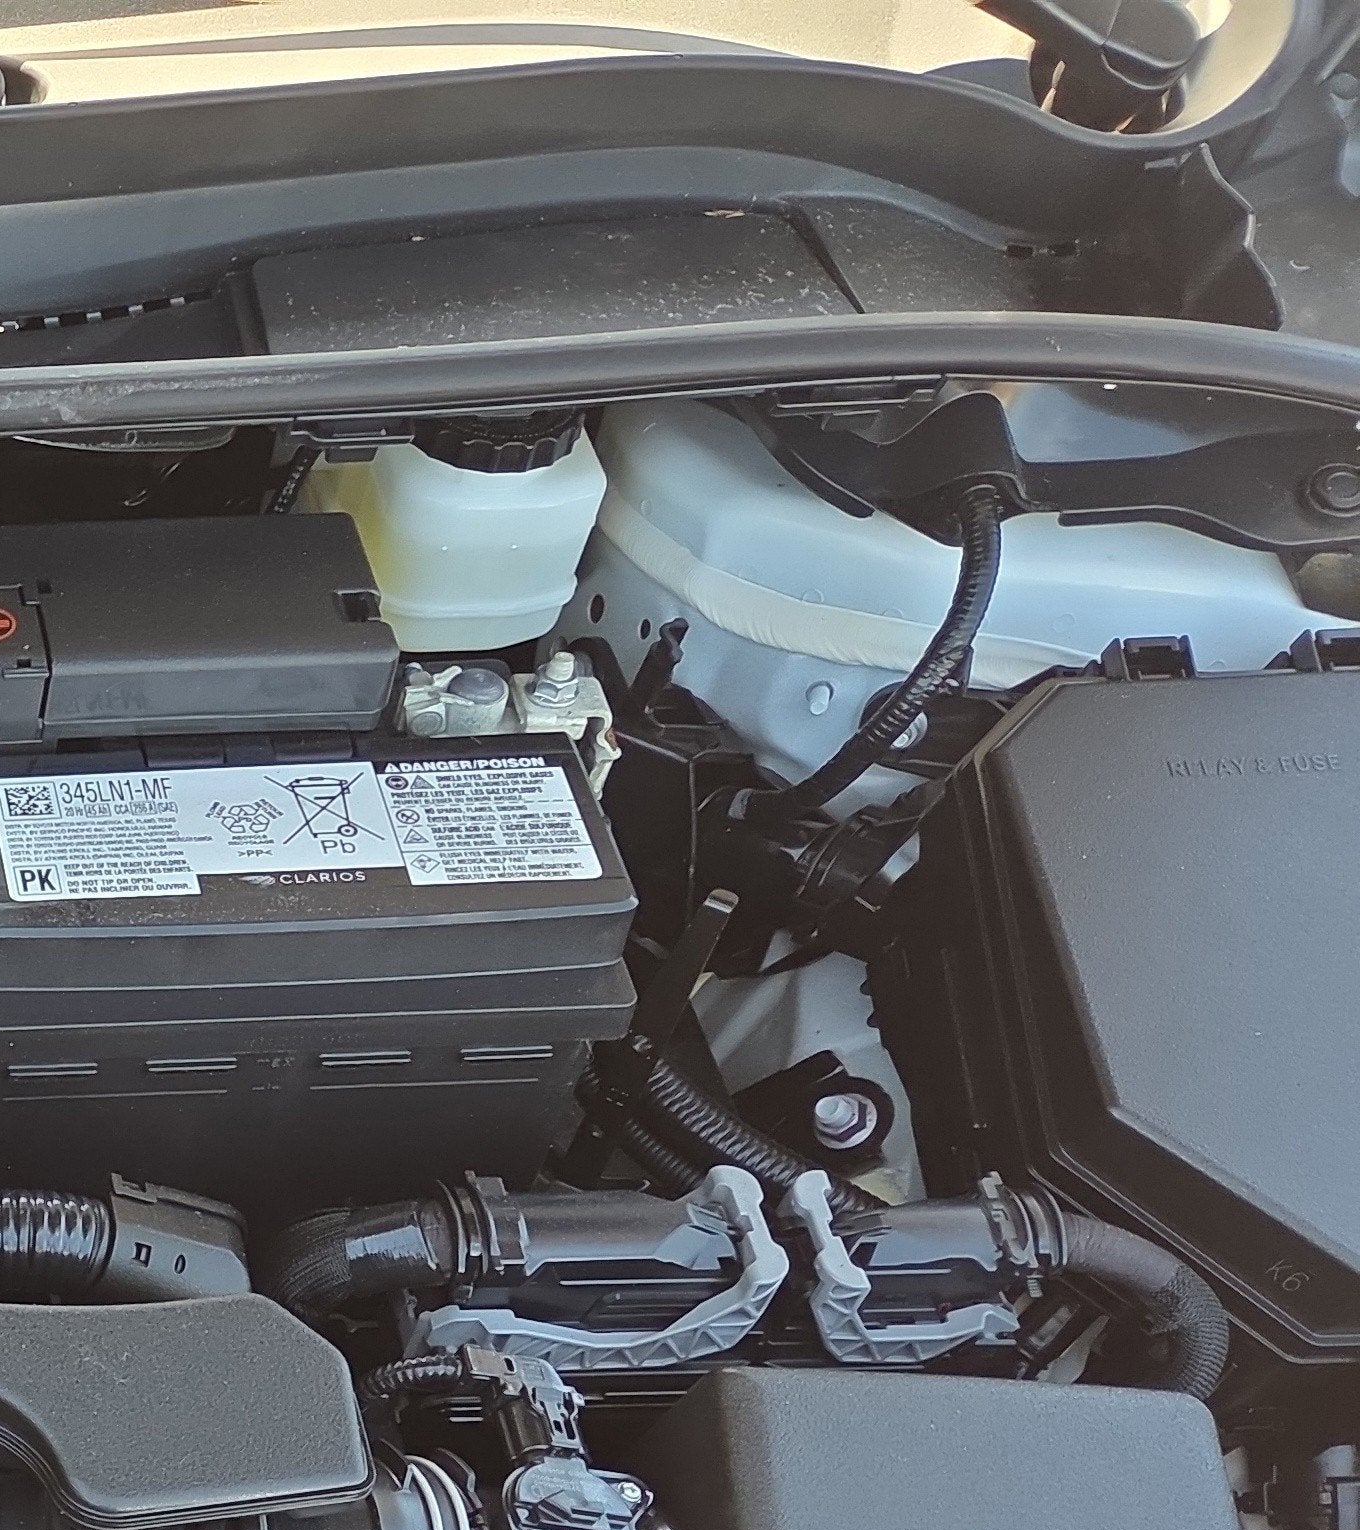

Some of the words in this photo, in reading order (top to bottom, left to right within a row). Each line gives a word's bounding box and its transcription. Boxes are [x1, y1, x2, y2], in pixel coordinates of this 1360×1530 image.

[399, 757, 546, 772] DANGER/POISON
[1278, 752, 1341, 774] FUSE
[60, 777, 172, 804] 345LN1-MF
[114, 804, 130, 815] CCA
[320, 839, 356, 854] Pb
[19, 868, 56, 893] PK
[279, 871, 366, 884] CLARIOS
[100, 885, 140, 893] INCLINER
